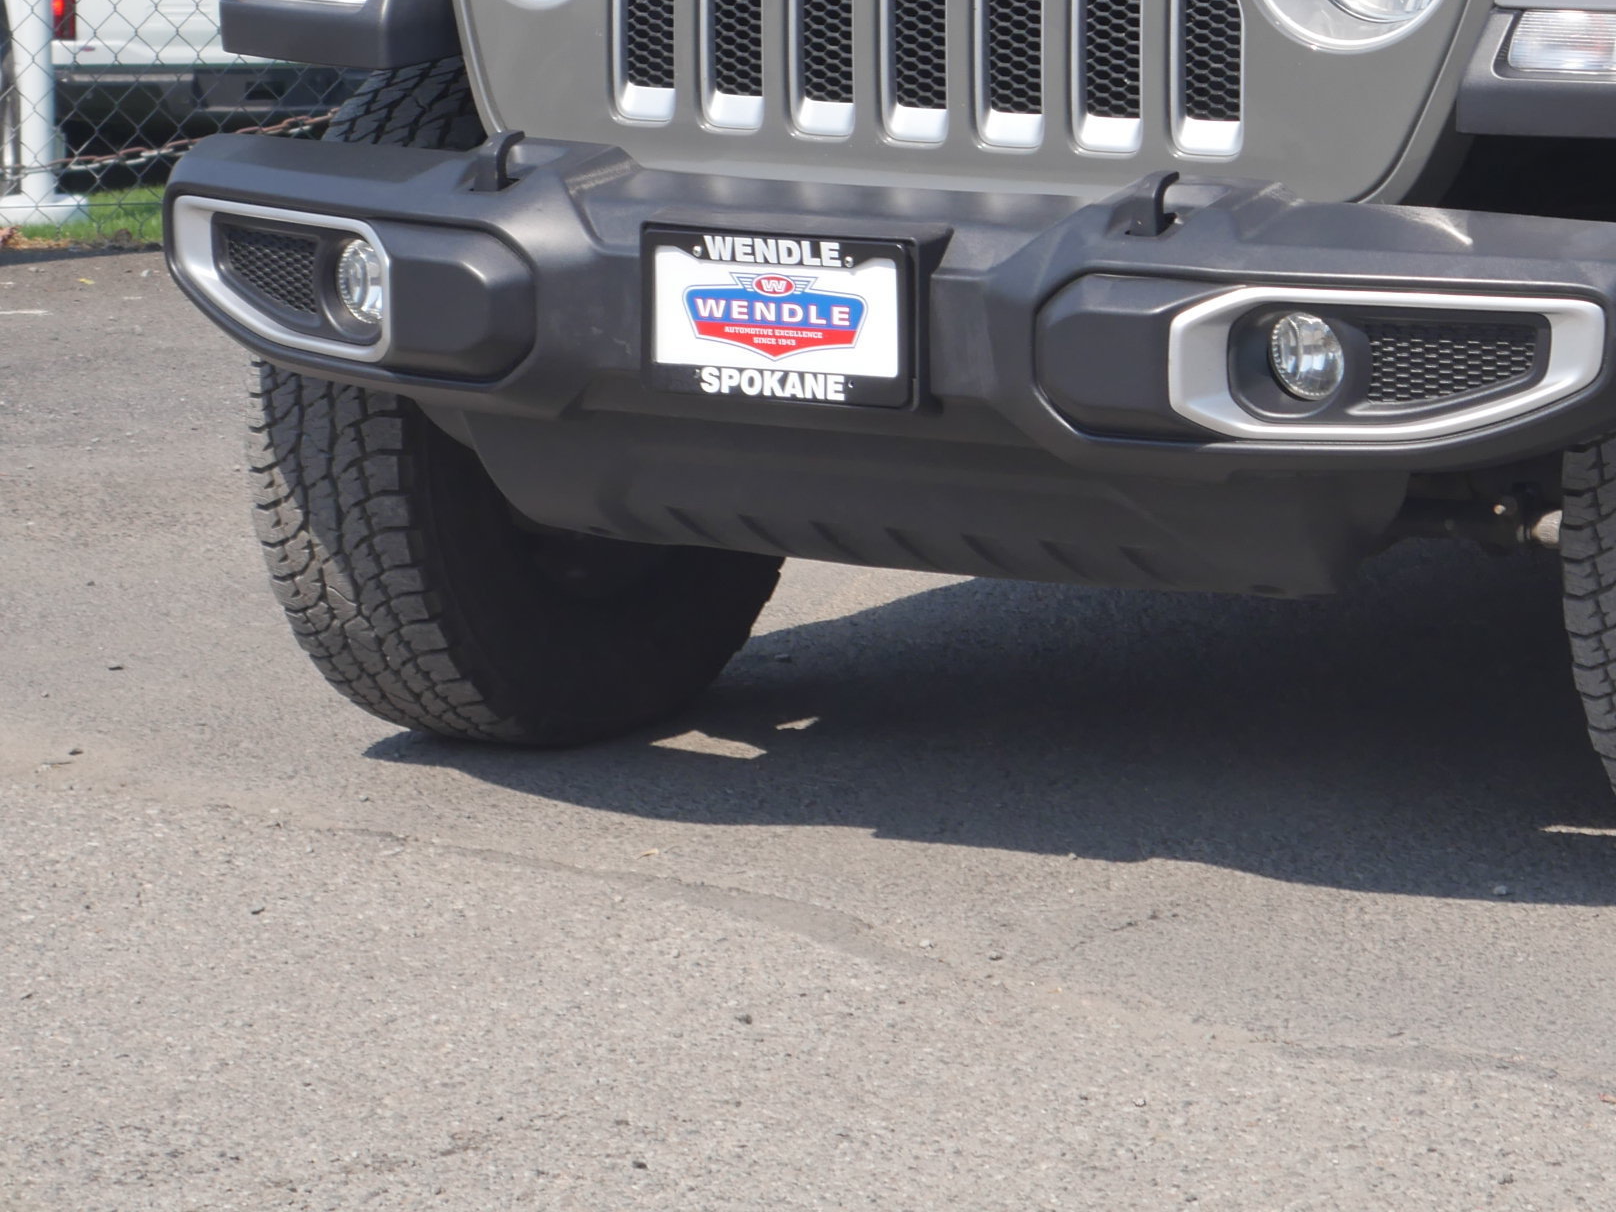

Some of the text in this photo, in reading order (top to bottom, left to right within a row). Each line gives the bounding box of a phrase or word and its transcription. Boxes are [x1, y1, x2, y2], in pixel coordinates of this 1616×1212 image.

[703, 235, 842, 267] WENDLE
[695, 298, 850, 326] WENDLE
[724, 326, 823, 339] AUTOMOTIVE EXCELLENCE
[753, 336, 796, 346] SINCE 1943
[700, 366, 845, 401] SPOKANE
